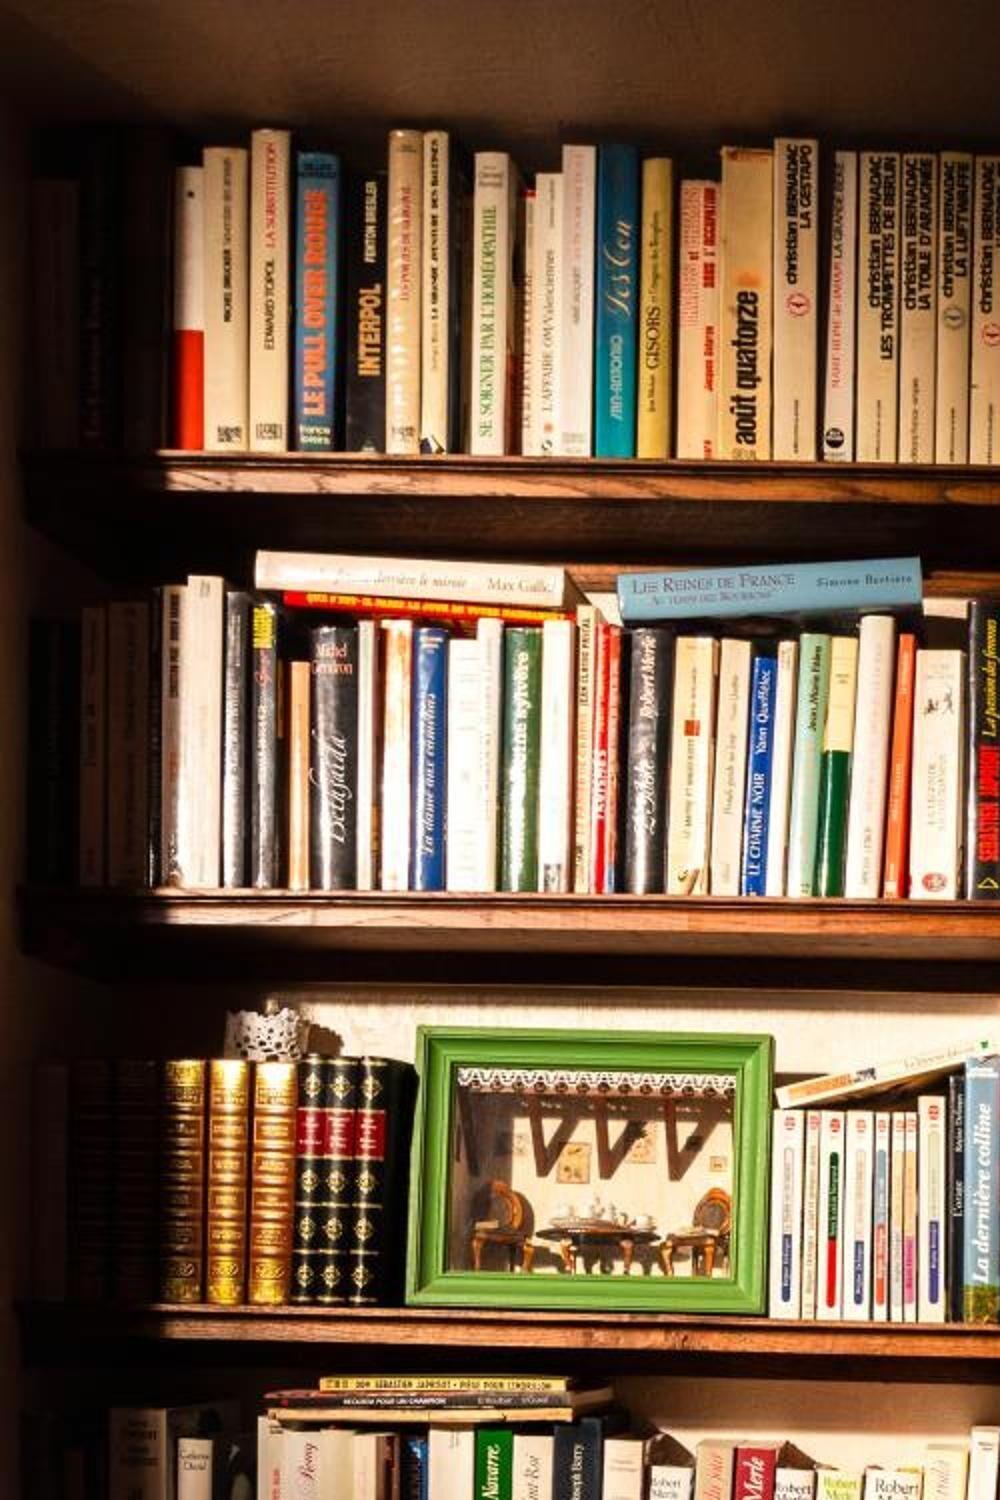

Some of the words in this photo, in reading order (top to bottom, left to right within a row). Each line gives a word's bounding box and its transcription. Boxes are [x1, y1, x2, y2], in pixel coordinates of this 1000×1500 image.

[264, 142, 278, 229] SUBSTITUTION
[787, 144, 799, 218] BERNADAC
[799, 145, 812, 207] GESTAPO
[869, 157, 882, 235] BERNADAC
[883, 157, 896, 207] BERLIN
[905, 159, 918, 237] BERNADAC
[943, 161, 955, 232] BERNADAC
[365, 181, 377, 223] BRESLER
[799, 212, 811, 228] LA
[882, 211, 895, 229] DE
[955, 161, 969, 252] LUFTWAFFE
[981, 162, 994, 240] BERNADAC
[265, 231, 276, 249] LA
[303, 190, 328, 265] ROUGE
[364, 224, 377, 263] FENTON
[786, 222, 798, 284] christian
[833, 242, 843, 259] LA
[868, 239, 881, 307] christian
[919, 251, 932, 291] TOILE
[942, 236, 954, 298] christian
[955, 257, 967, 277] LA
[264, 259, 275, 297] TOPOL
[881, 233, 895, 330] TROMPETTES
[904, 241, 917, 309] christian
[980, 245, 993, 314] christian
[303, 268, 327, 328] OVER
[919, 294, 931, 309] LA
[264, 299, 276, 350] EDWARD
[358, 283, 382, 376] INTERPOL
[480, 322, 496, 350] PAR
[645, 306, 661, 370] GISORS
[731, 291, 761, 390] quatorze
[881, 335, 893, 359] LES
[303, 332, 327, 387] PULL
[302, 391, 327, 417] LE
[479, 354, 495, 416] SOIGNER
[542, 352, 555, 413] L'AFFAIRE
[478, 420, 492, 437] SE
[730, 396, 757, 444] août
[488, 577, 515, 591] Max
[739, 573, 795, 589] FRANCE
[816, 577, 859, 587] Simone
[581, 618, 590, 649] PASCAL
[640, 636, 656, 674] Merle
[981, 619, 1000, 660] femmes
[981, 661, 996, 677] des
[579, 685, 590, 706] JEAN
[640, 676, 658, 719] Robert
[755, 727, 768, 754] Yann
[981, 719, 997, 737] La
[752, 773, 764, 804] NOIR
[750, 808, 762, 859] CHARME
[749, 861, 761, 876] LE
[973, 1103, 991, 1166] colline
[970, 1171, 991, 1253] dernière
[973, 1256, 991, 1281] La
[481, 1445, 500, 1500] Navarre
[823, 1476, 857, 1489] Robert
[875, 1478, 918, 1495] Robert
